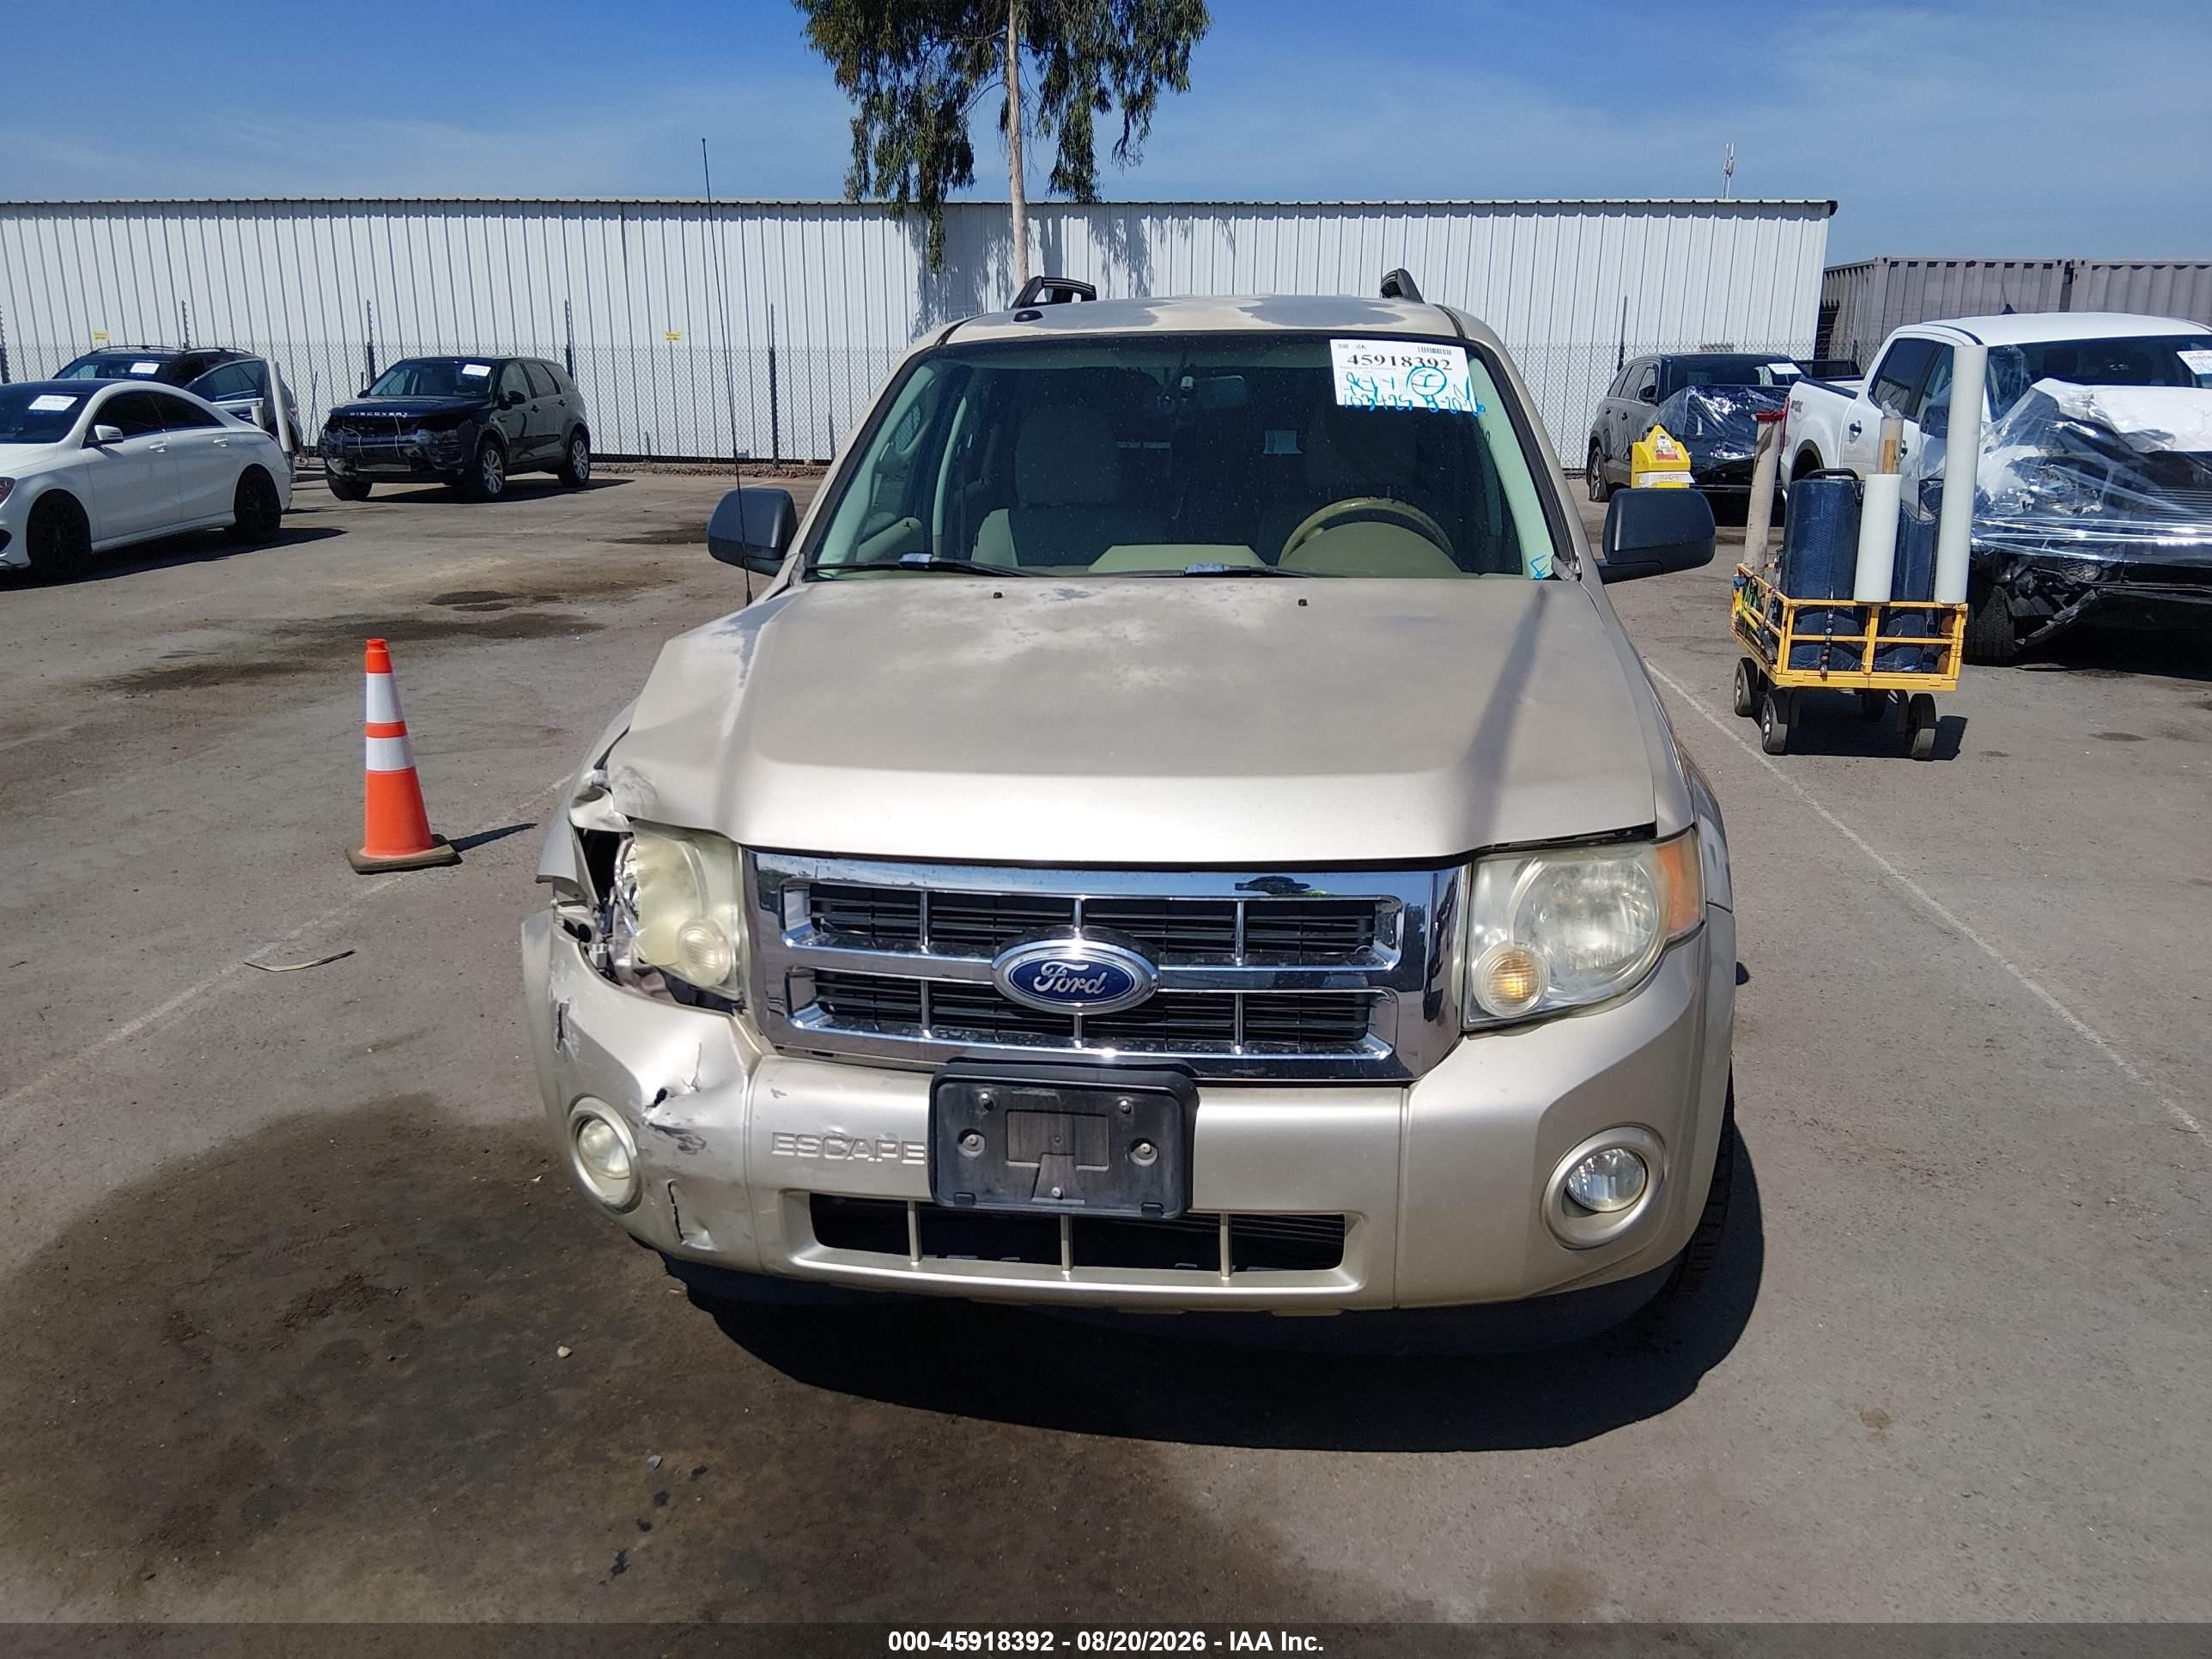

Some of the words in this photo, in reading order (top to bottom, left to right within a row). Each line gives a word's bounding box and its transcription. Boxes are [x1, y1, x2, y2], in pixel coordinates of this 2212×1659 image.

[1346, 354, 1453, 371] 45918392
[1033, 961, 1108, 994] Ford
[771, 1132, 925, 1165] ESCAPE
